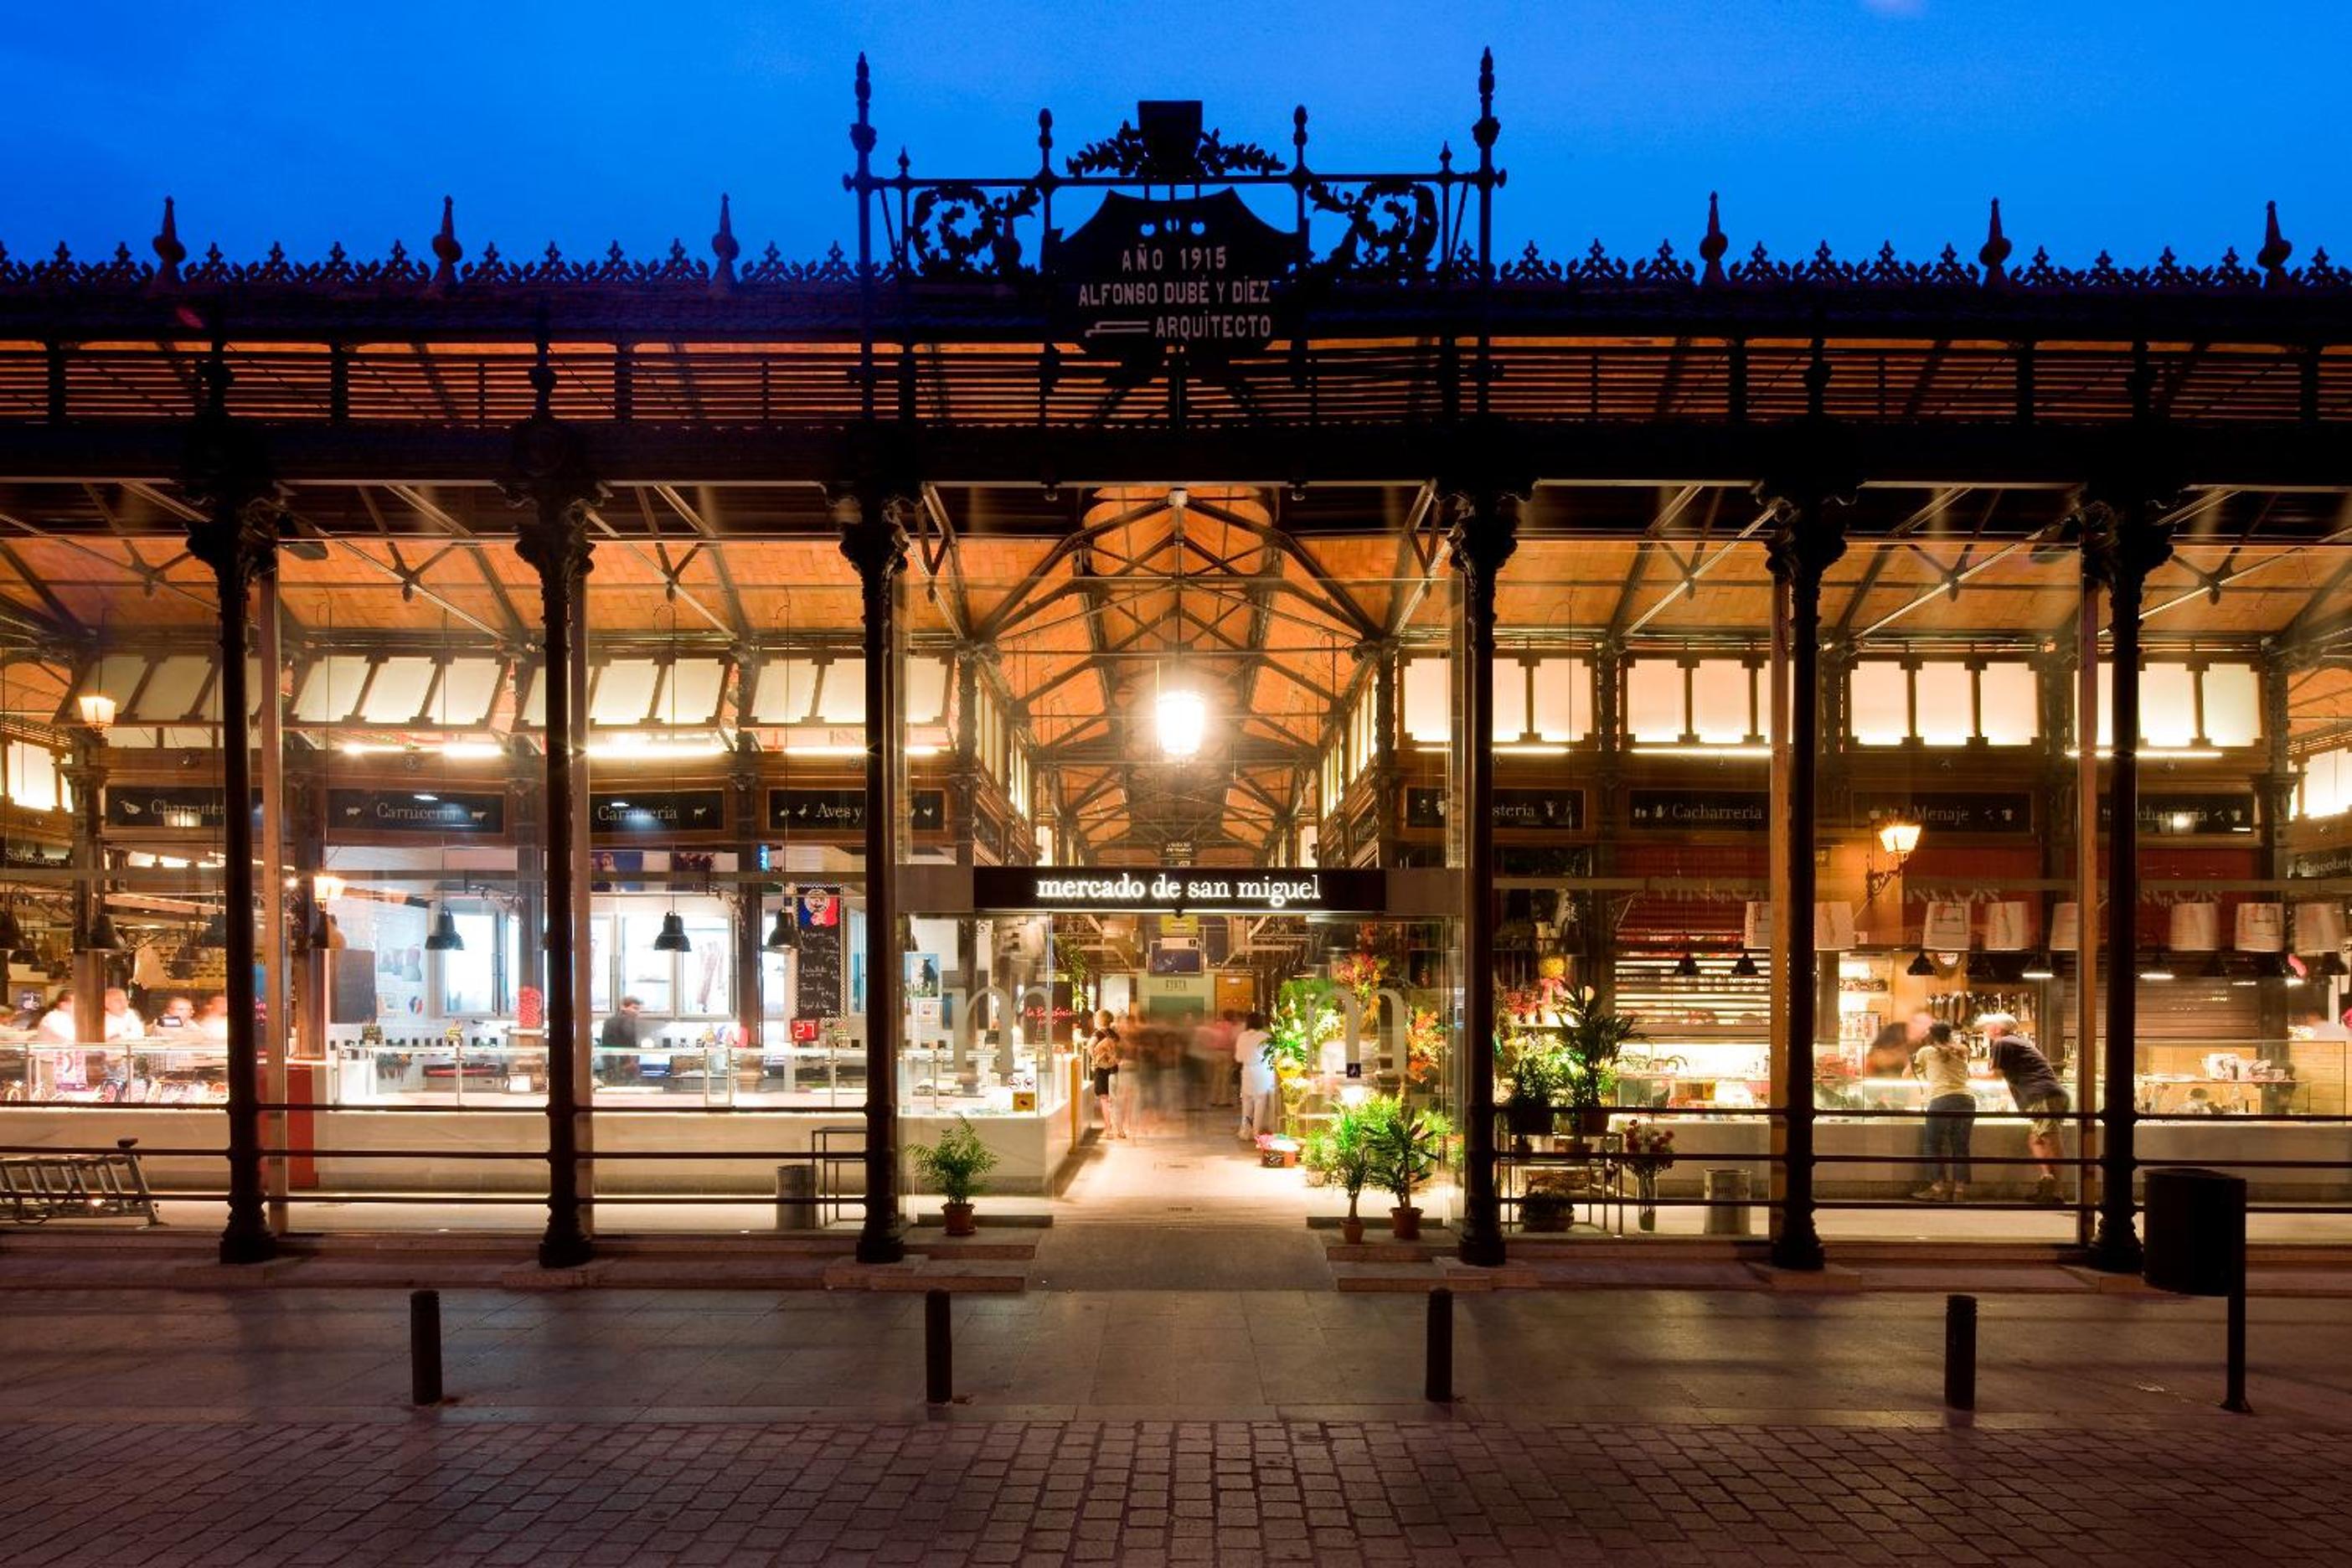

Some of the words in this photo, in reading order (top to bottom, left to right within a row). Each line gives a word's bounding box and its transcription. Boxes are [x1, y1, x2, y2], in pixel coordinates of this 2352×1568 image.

[1122, 243, 1164, 271] AÑO
[1179, 245, 1226, 271] 1915
[1078, 281, 1158, 307] ALFONSO
[1163, 275, 1210, 305] DUBÉ
[1216, 281, 1226, 304] Y
[151, 798, 224, 815] Charcuter
[815, 802, 851, 818] Aves
[854, 807, 864, 822] y
[1913, 804, 1969, 826] Menaje
[1037, 873, 1145, 899] mercado
[1151, 874, 1181, 899] de
[1188, 877, 1230, 900] san
[1238, 874, 1321, 907] miguel
[794, 1023, 815, 1039] 27
